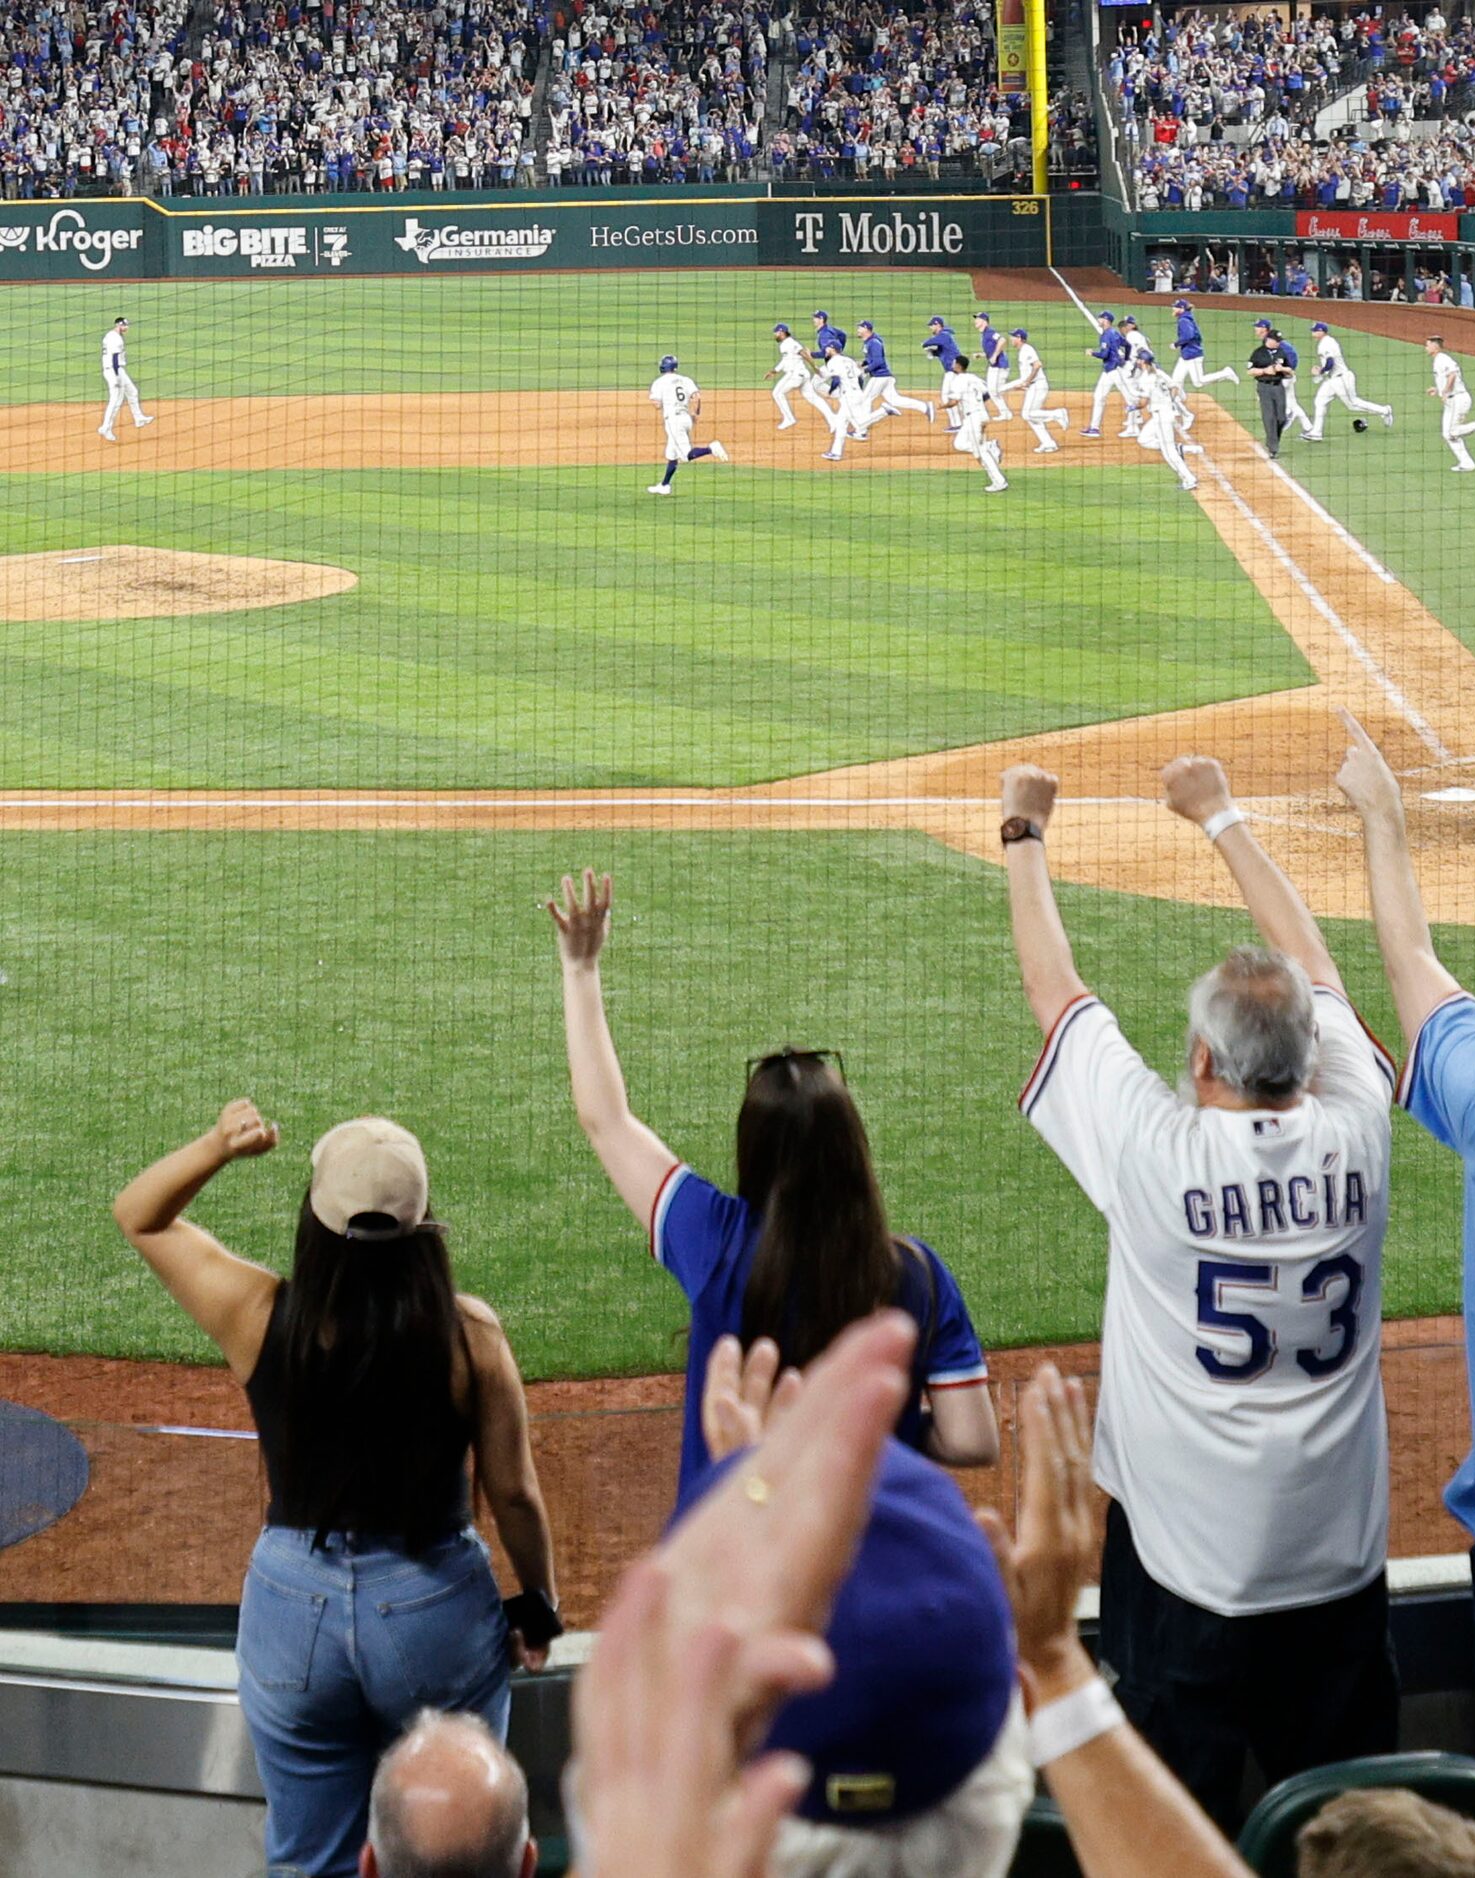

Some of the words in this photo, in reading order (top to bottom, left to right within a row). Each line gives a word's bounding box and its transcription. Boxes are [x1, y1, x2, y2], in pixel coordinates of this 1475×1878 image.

[1012, 201, 1039, 215] 326
[36, 209, 143, 270] Kroger
[590, 224, 758, 248] HeGetsUs.com
[839, 212, 964, 254] Mobile
[251, 254, 296, 267] PIZZA
[448, 248, 531, 256] INSURANCE
[675, 386, 686, 402] 6
[1184, 1152, 1368, 1240] GARCÍA
[1195, 1253, 1366, 1385] 53
